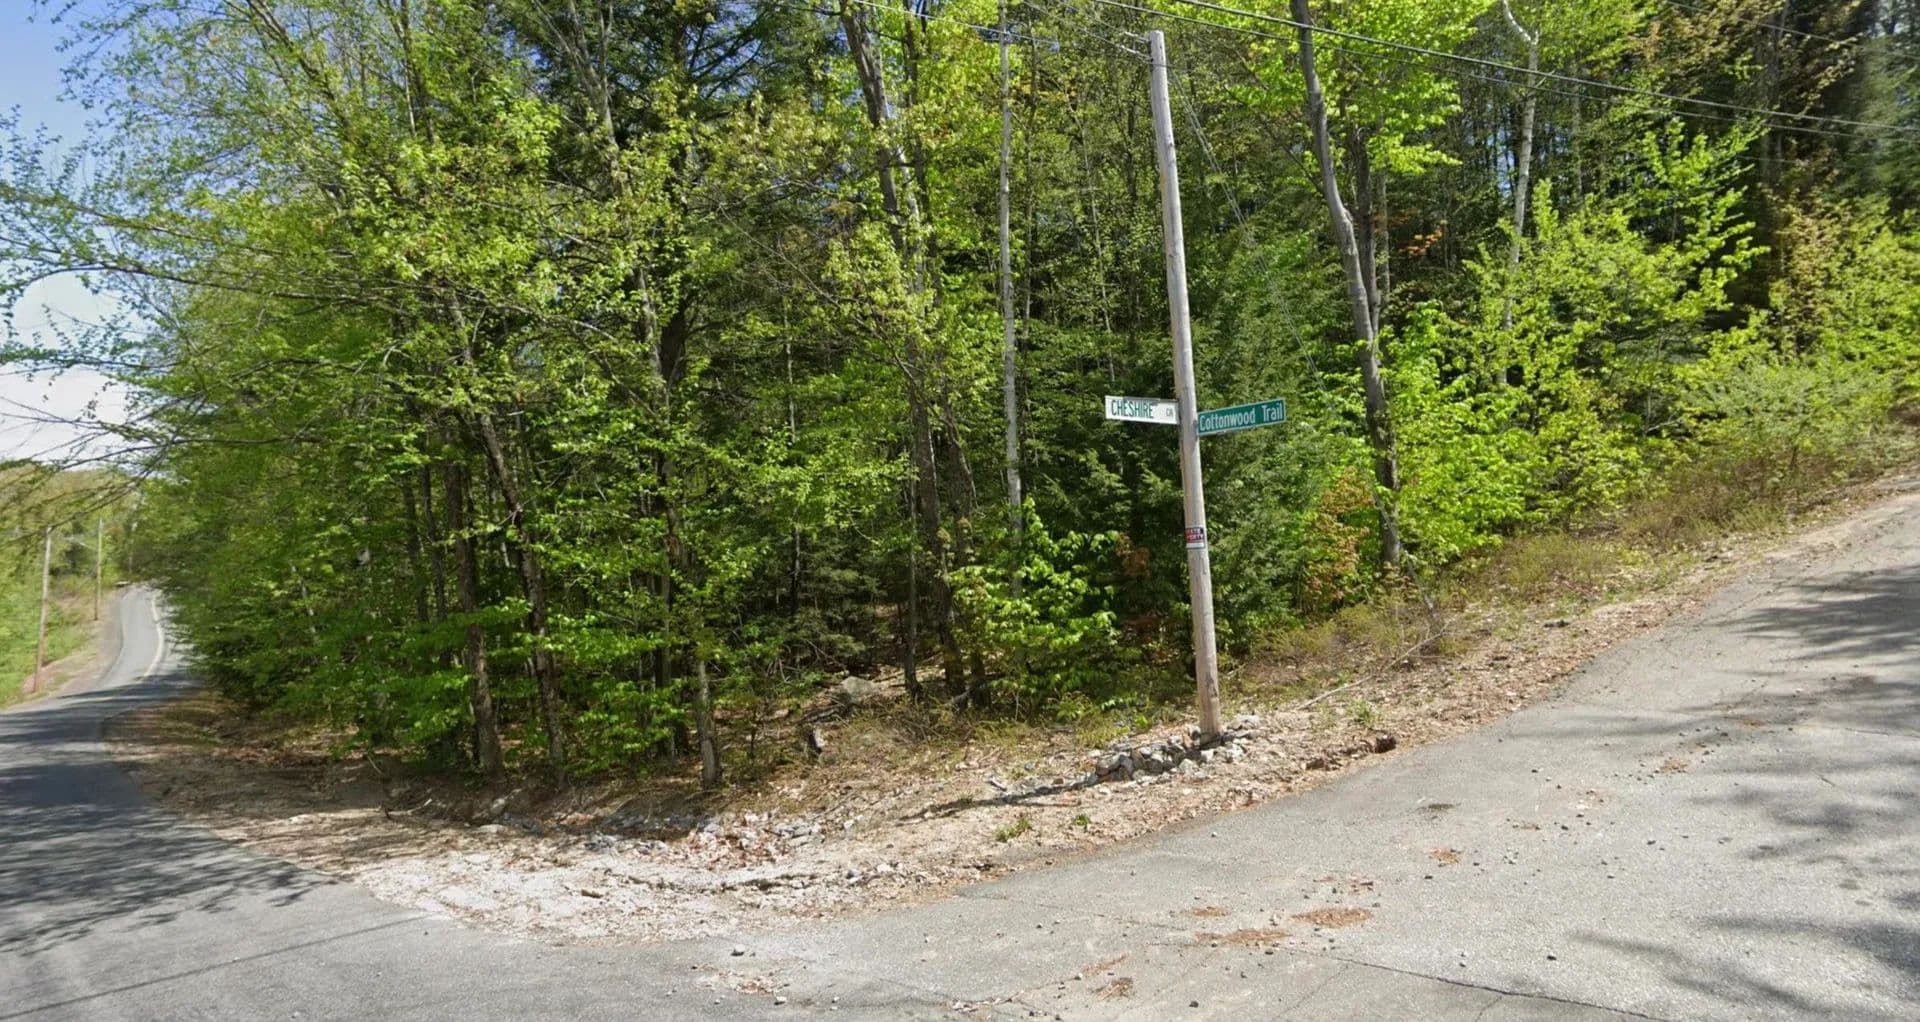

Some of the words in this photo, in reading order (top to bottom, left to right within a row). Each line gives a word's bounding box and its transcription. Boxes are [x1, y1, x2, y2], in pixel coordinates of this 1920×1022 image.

[1111, 400, 1154, 419] CHESHIRE
[1200, 408, 1256, 432] Cottonwood
[1261, 402, 1283, 422] Trail
